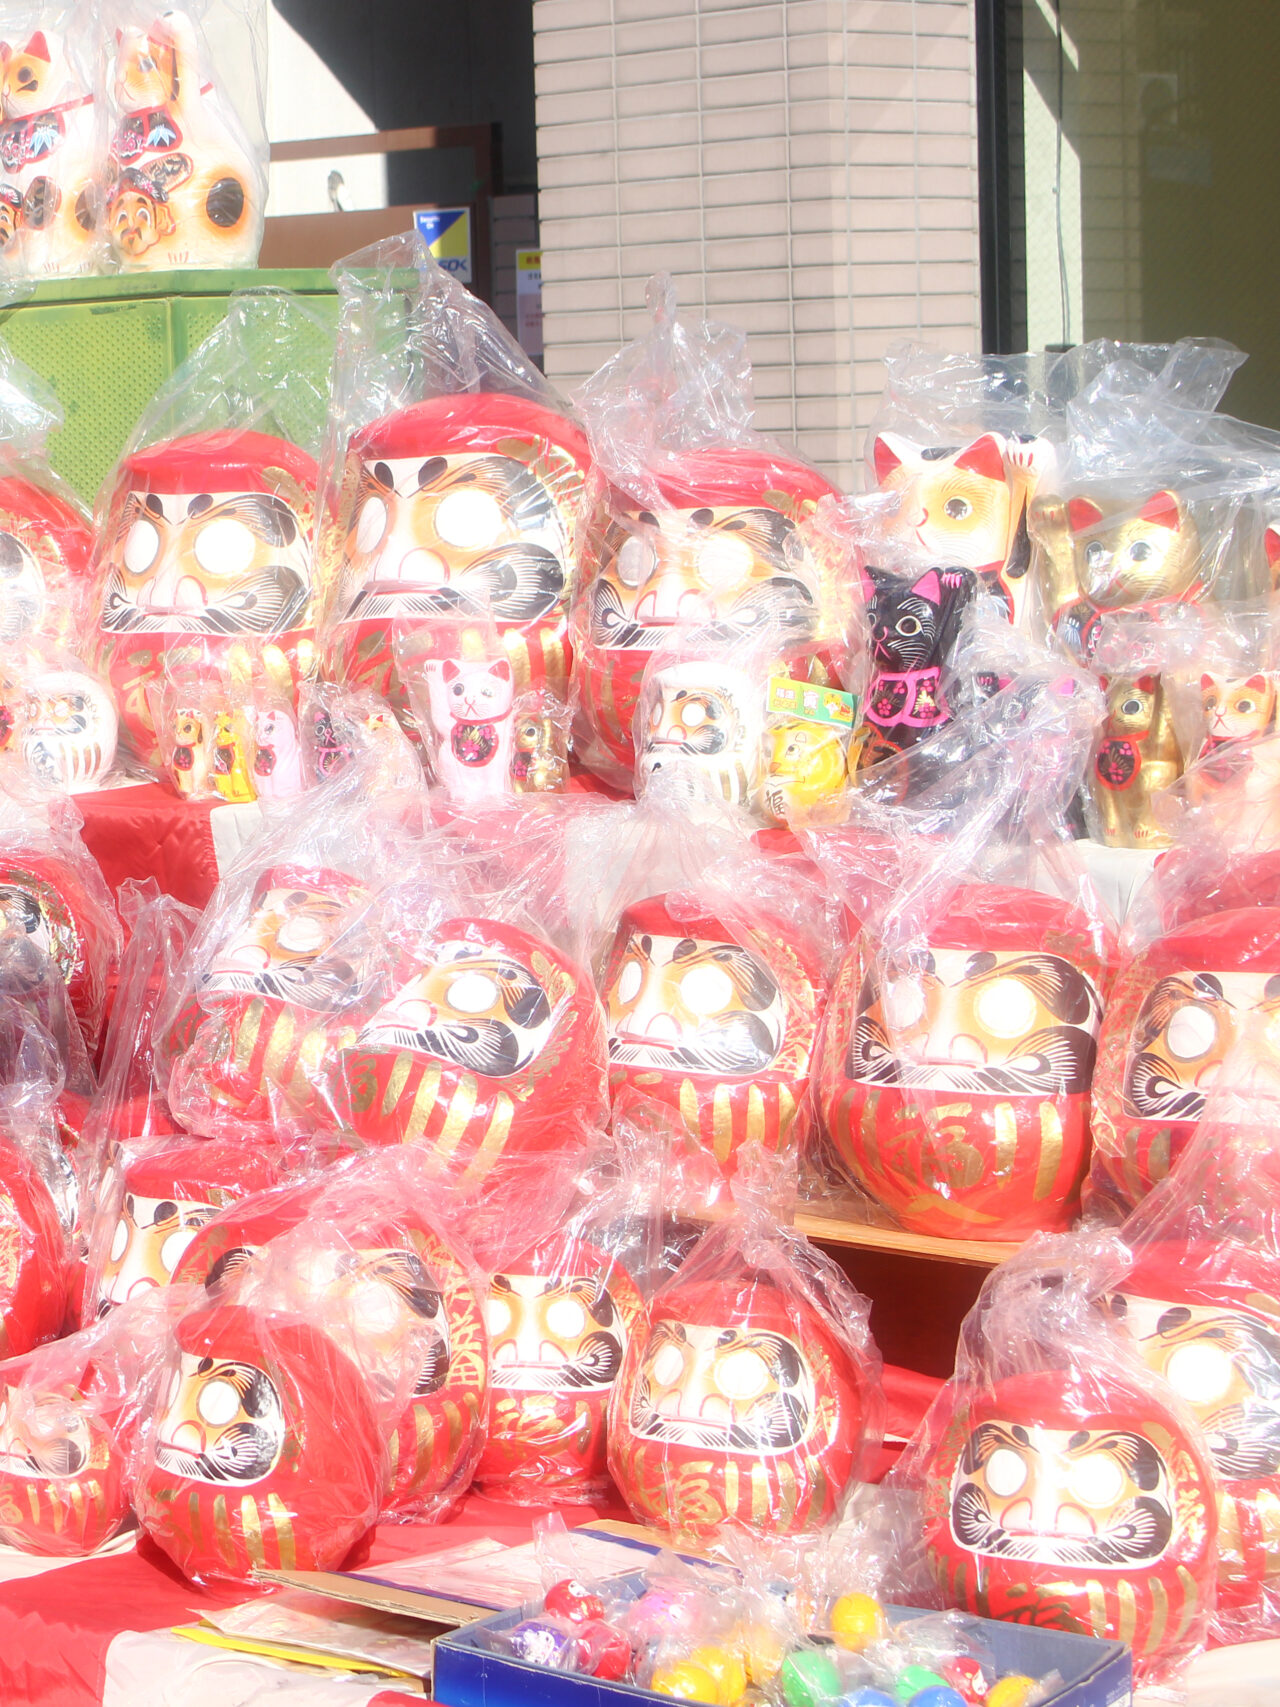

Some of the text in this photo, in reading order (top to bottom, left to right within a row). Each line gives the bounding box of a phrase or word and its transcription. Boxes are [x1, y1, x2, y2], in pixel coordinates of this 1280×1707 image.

[884, 1101, 984, 1190] 福
[494, 1395, 569, 1461] 福
[644, 1460, 723, 1526] 福
